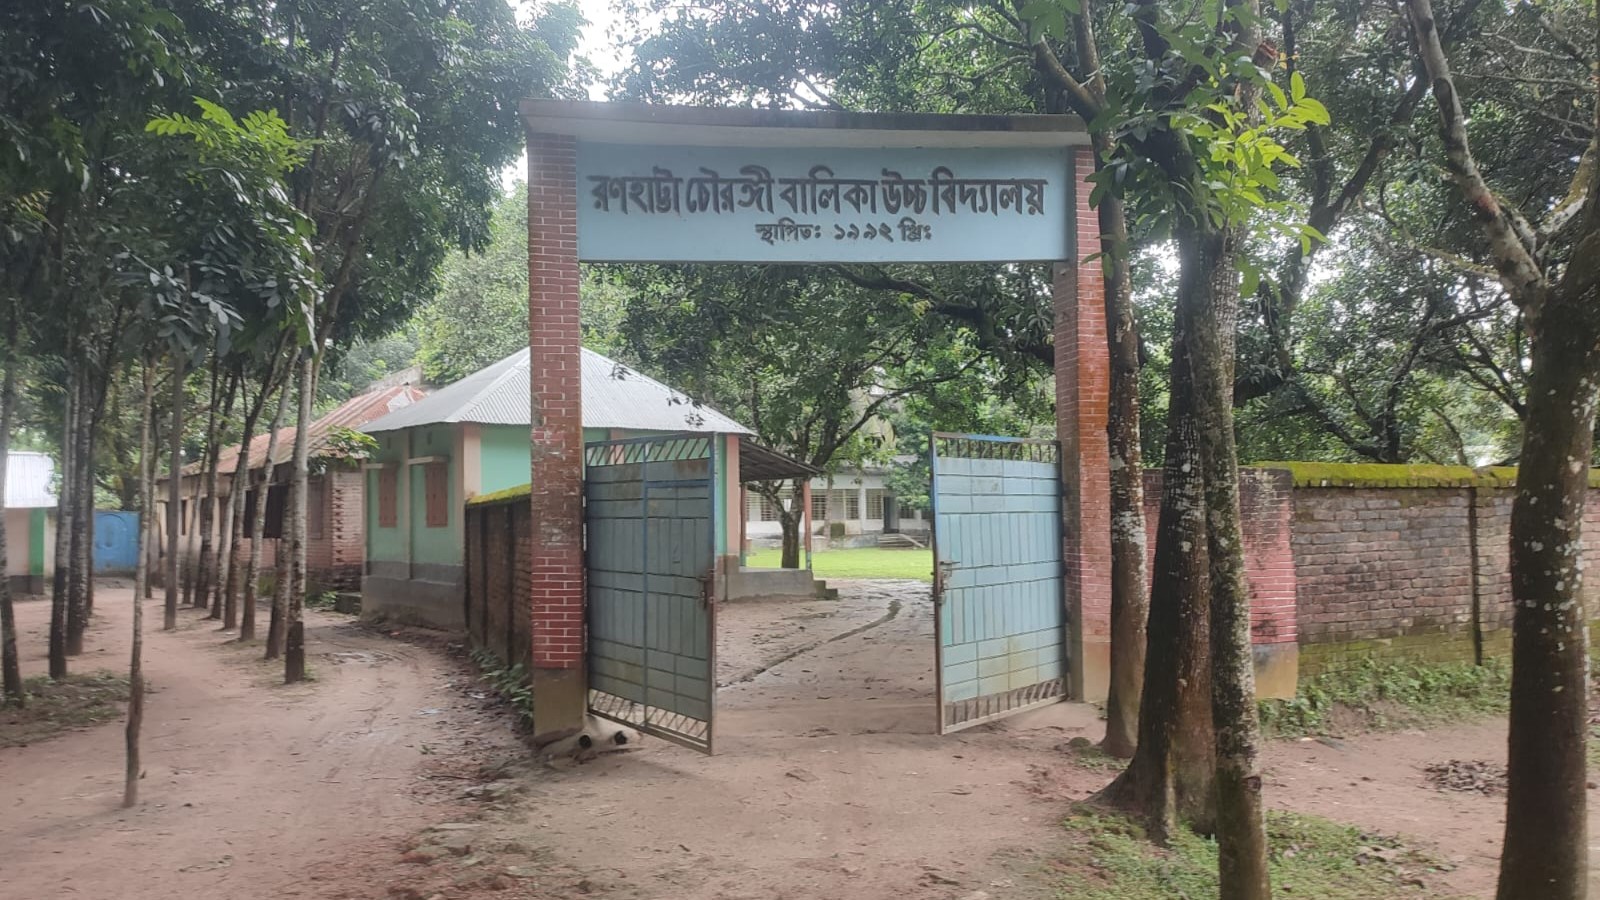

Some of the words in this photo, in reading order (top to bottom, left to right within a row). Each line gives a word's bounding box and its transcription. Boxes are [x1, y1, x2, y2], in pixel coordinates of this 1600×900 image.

[779, 165, 878, 215] বালিকা
[881, 168, 927, 215] উচ্চ
[928, 166, 1048, 216] বিদ্যালয়
[834, 222, 894, 243] ১৯৯২
